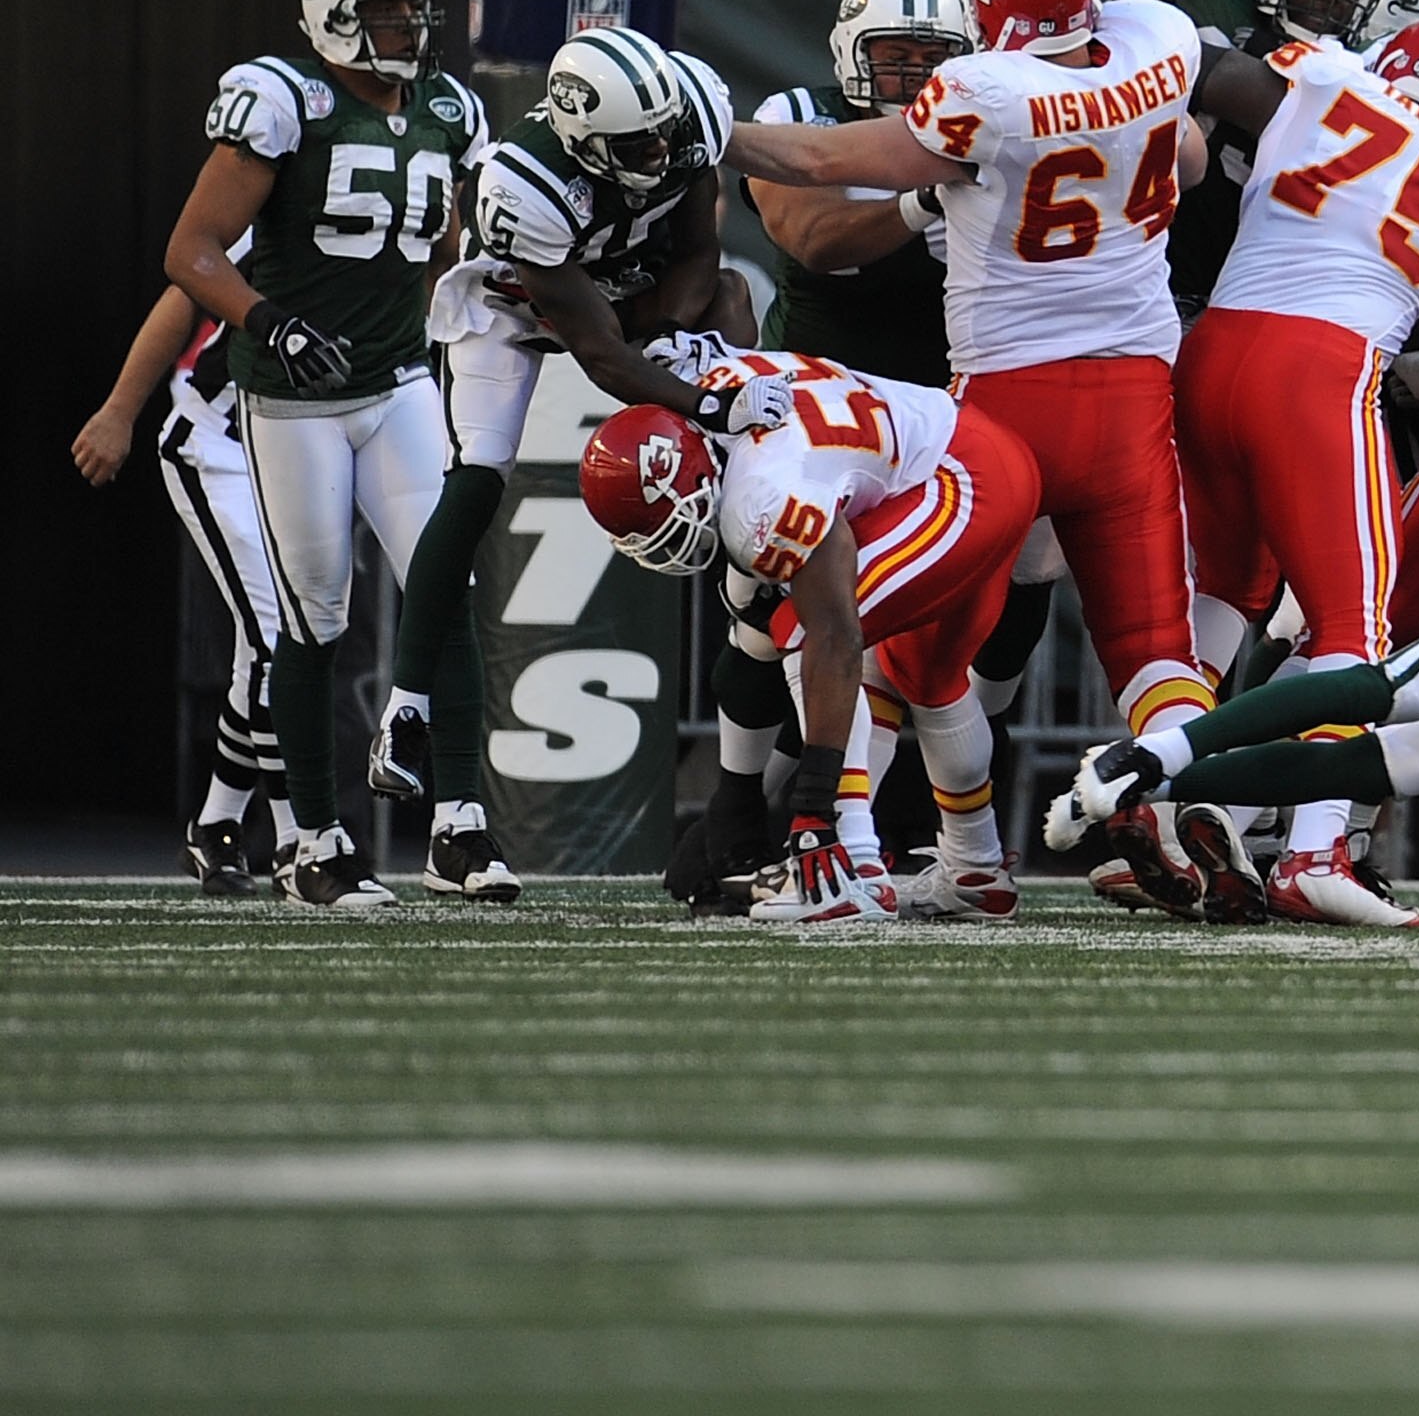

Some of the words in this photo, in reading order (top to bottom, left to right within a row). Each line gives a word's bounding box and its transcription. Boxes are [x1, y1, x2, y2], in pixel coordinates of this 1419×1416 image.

[1037, 21, 1056, 35] GU
[1028, 53, 1188, 138] NISWANGER
[313, 143, 455, 264] 50
[1013, 116, 1179, 264] 64
